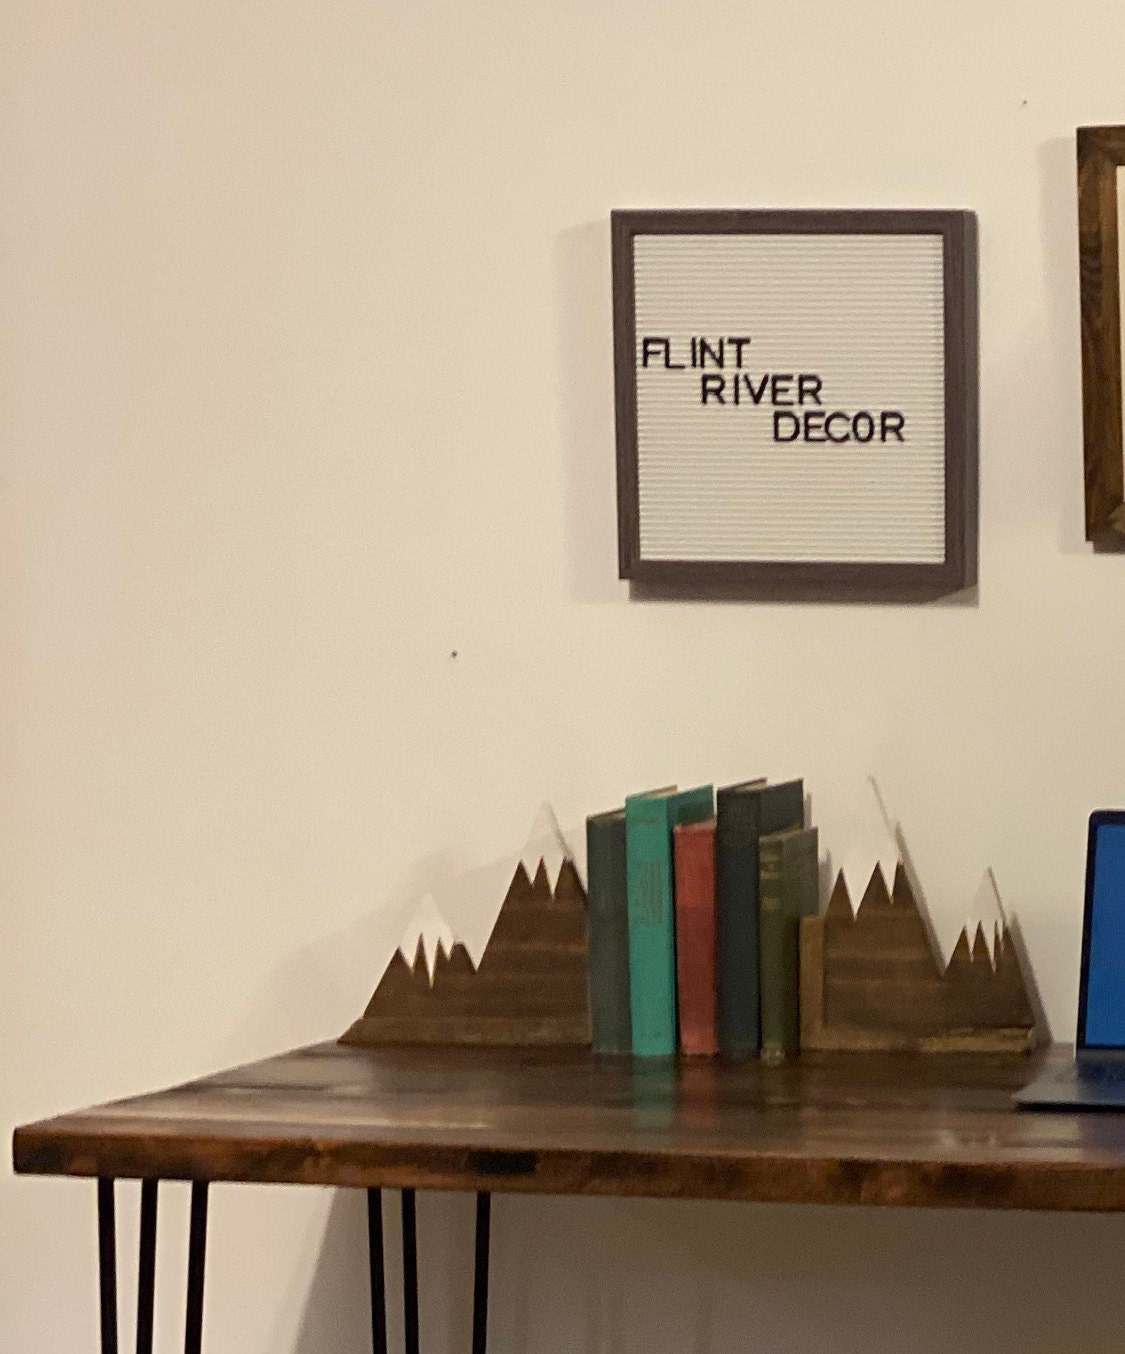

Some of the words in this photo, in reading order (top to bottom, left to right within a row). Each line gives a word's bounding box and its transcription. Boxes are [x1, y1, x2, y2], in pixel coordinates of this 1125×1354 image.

[641, 336, 751, 370] FLINT
[701, 374, 823, 406] RIVER
[773, 411, 905, 443] DECOR
